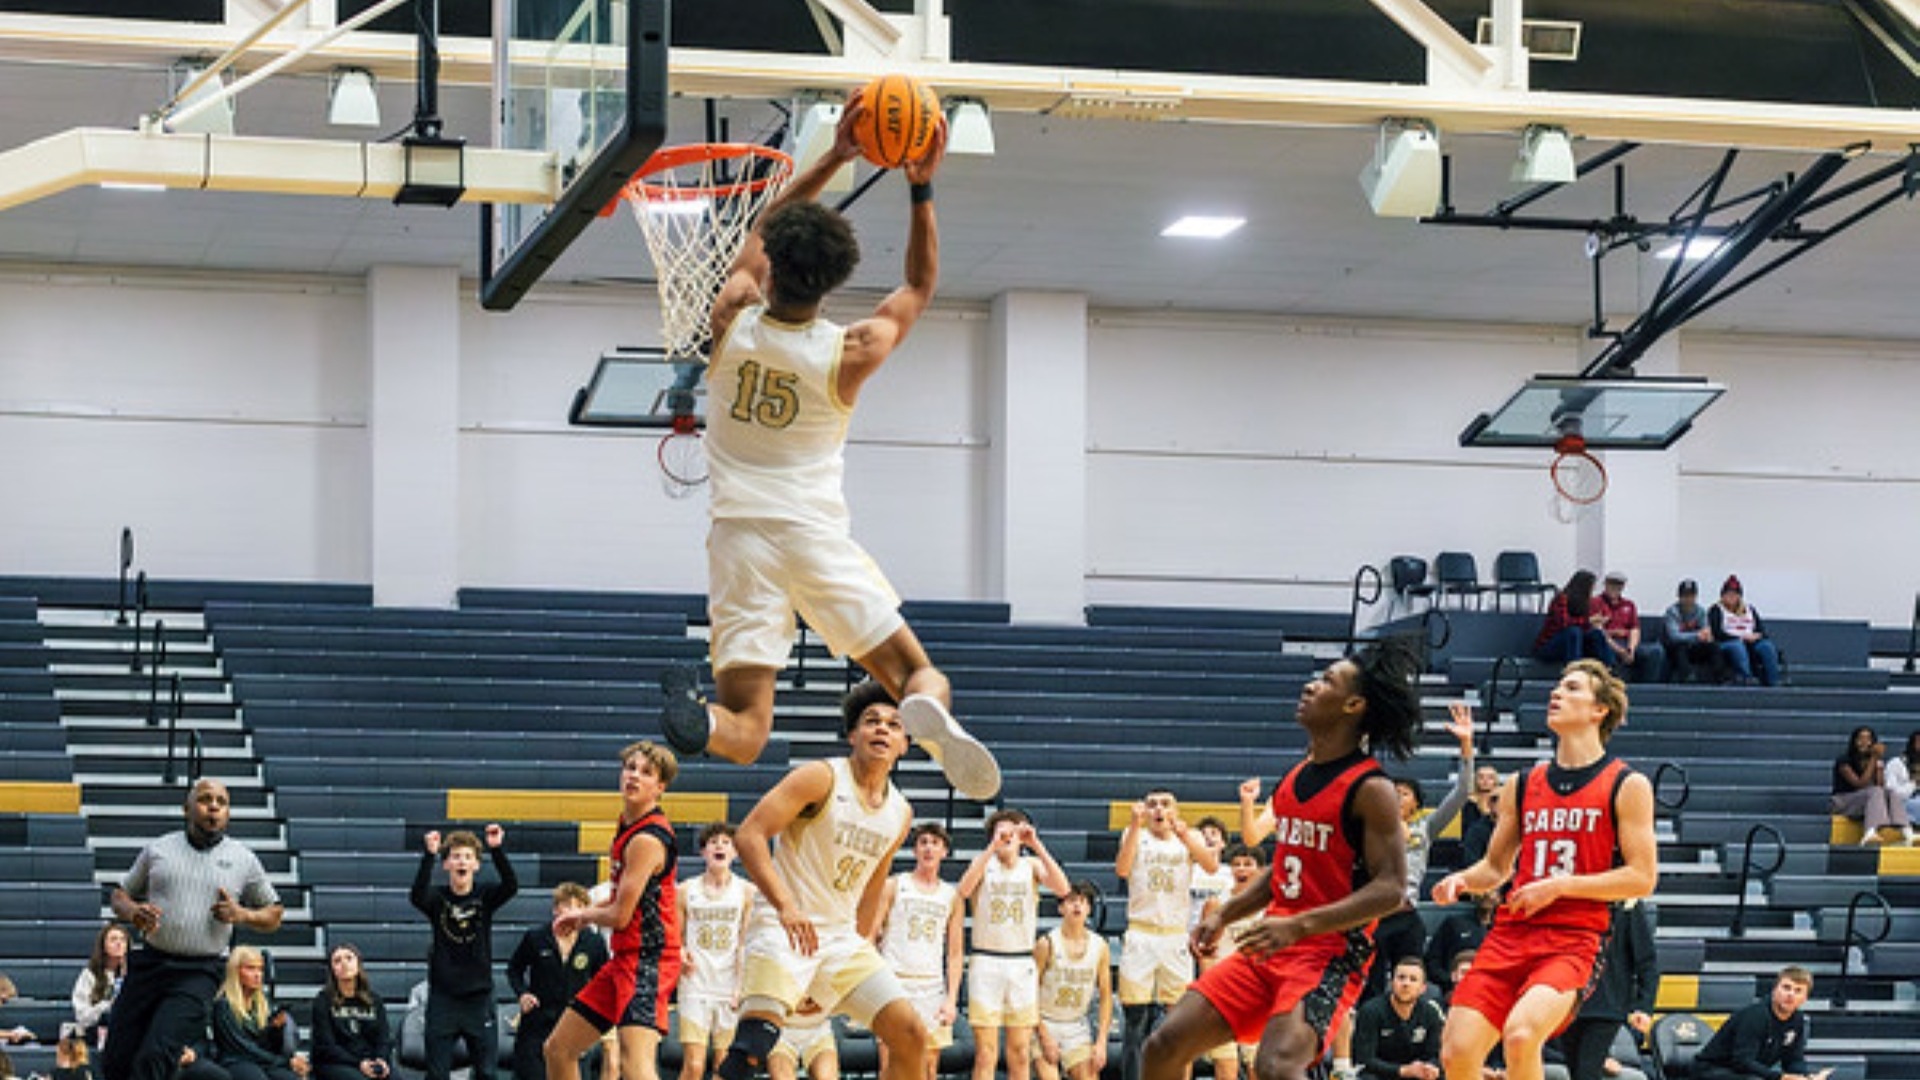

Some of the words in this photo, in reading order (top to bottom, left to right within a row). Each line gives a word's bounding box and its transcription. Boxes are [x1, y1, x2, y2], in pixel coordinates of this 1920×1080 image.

[731, 359, 799, 429] 15
[1276, 816, 1334, 851] ABOT
[1533, 839, 1577, 879] 13
